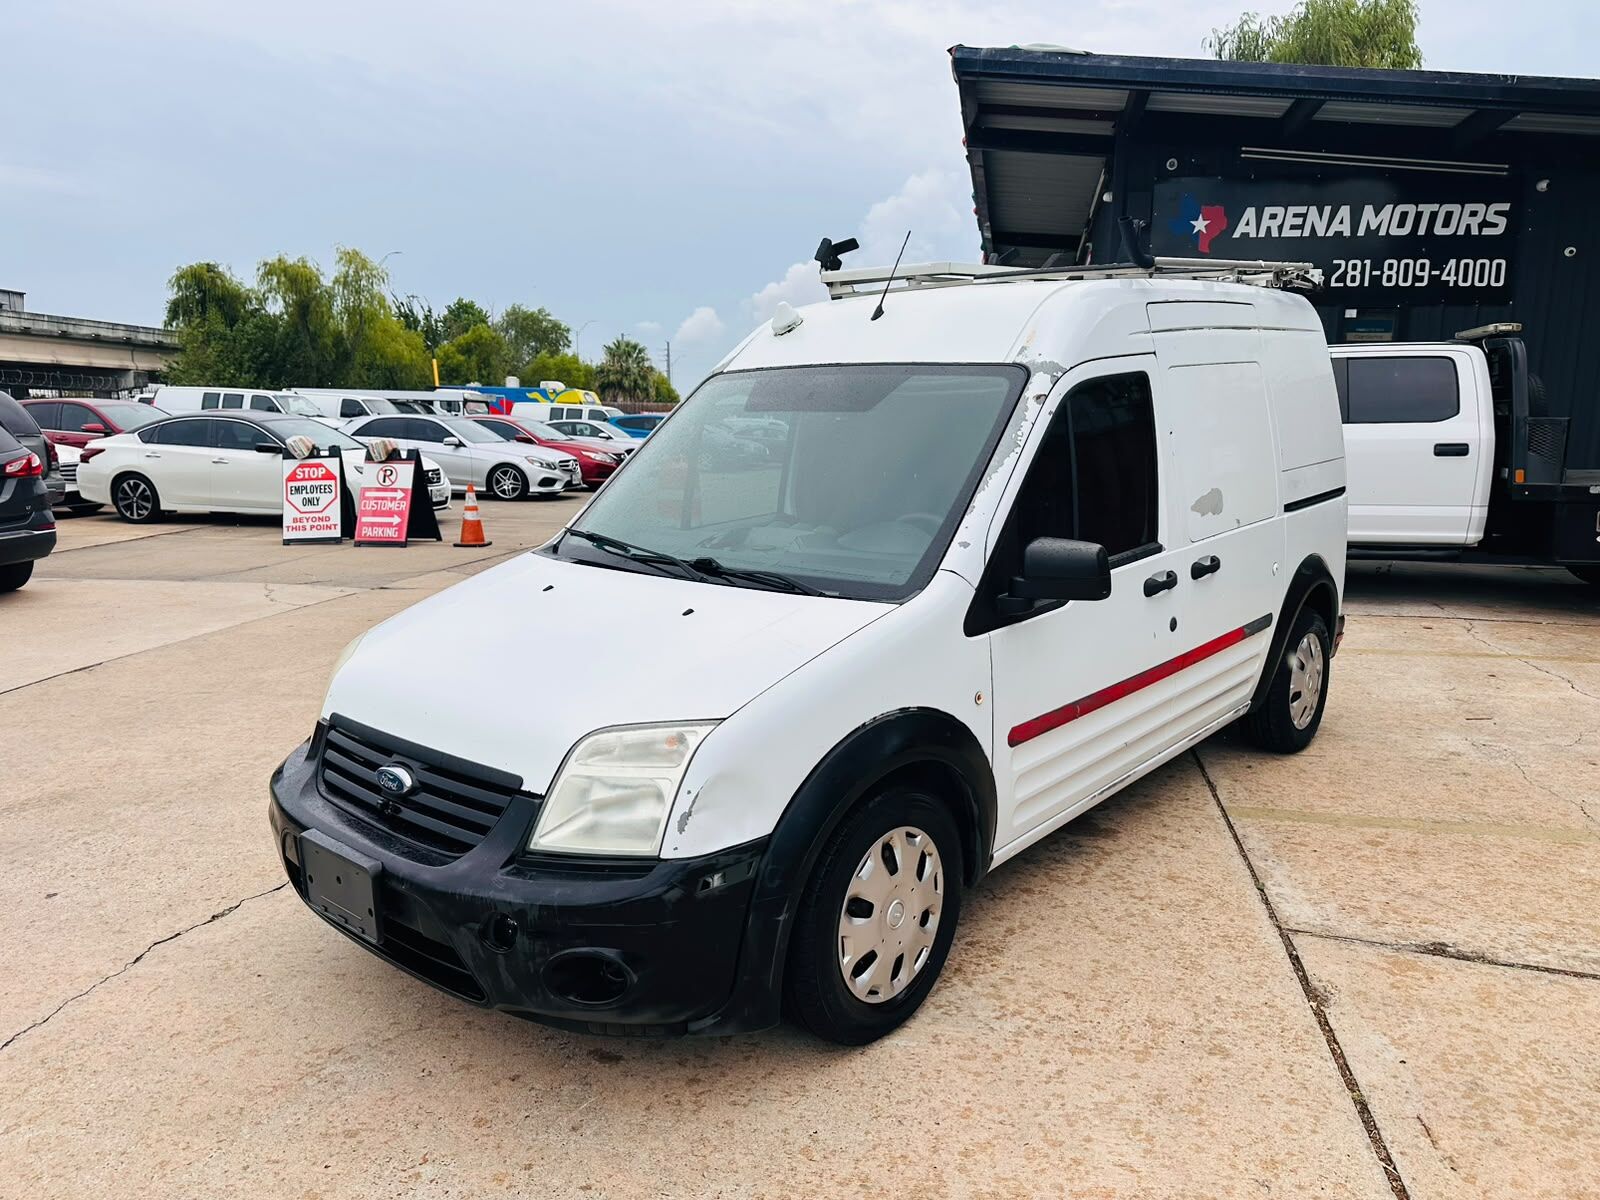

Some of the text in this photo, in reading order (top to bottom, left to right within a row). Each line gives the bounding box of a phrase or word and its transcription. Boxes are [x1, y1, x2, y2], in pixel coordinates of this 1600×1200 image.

[1232, 203, 1511, 238] ARENA MOTORS
[1331, 258, 1506, 287] 281-809-4000
[296, 467, 326, 479] STOP
[290, 484, 333, 495] EMPLOYEES
[302, 497, 320, 507] ONLY
[361, 500, 407, 510] CUSTOMER
[292, 516, 331, 524] BEYOND
[309, 523, 338, 531] POINT
[361, 527, 398, 538] PARKING
[380, 772, 399, 791] Ford
